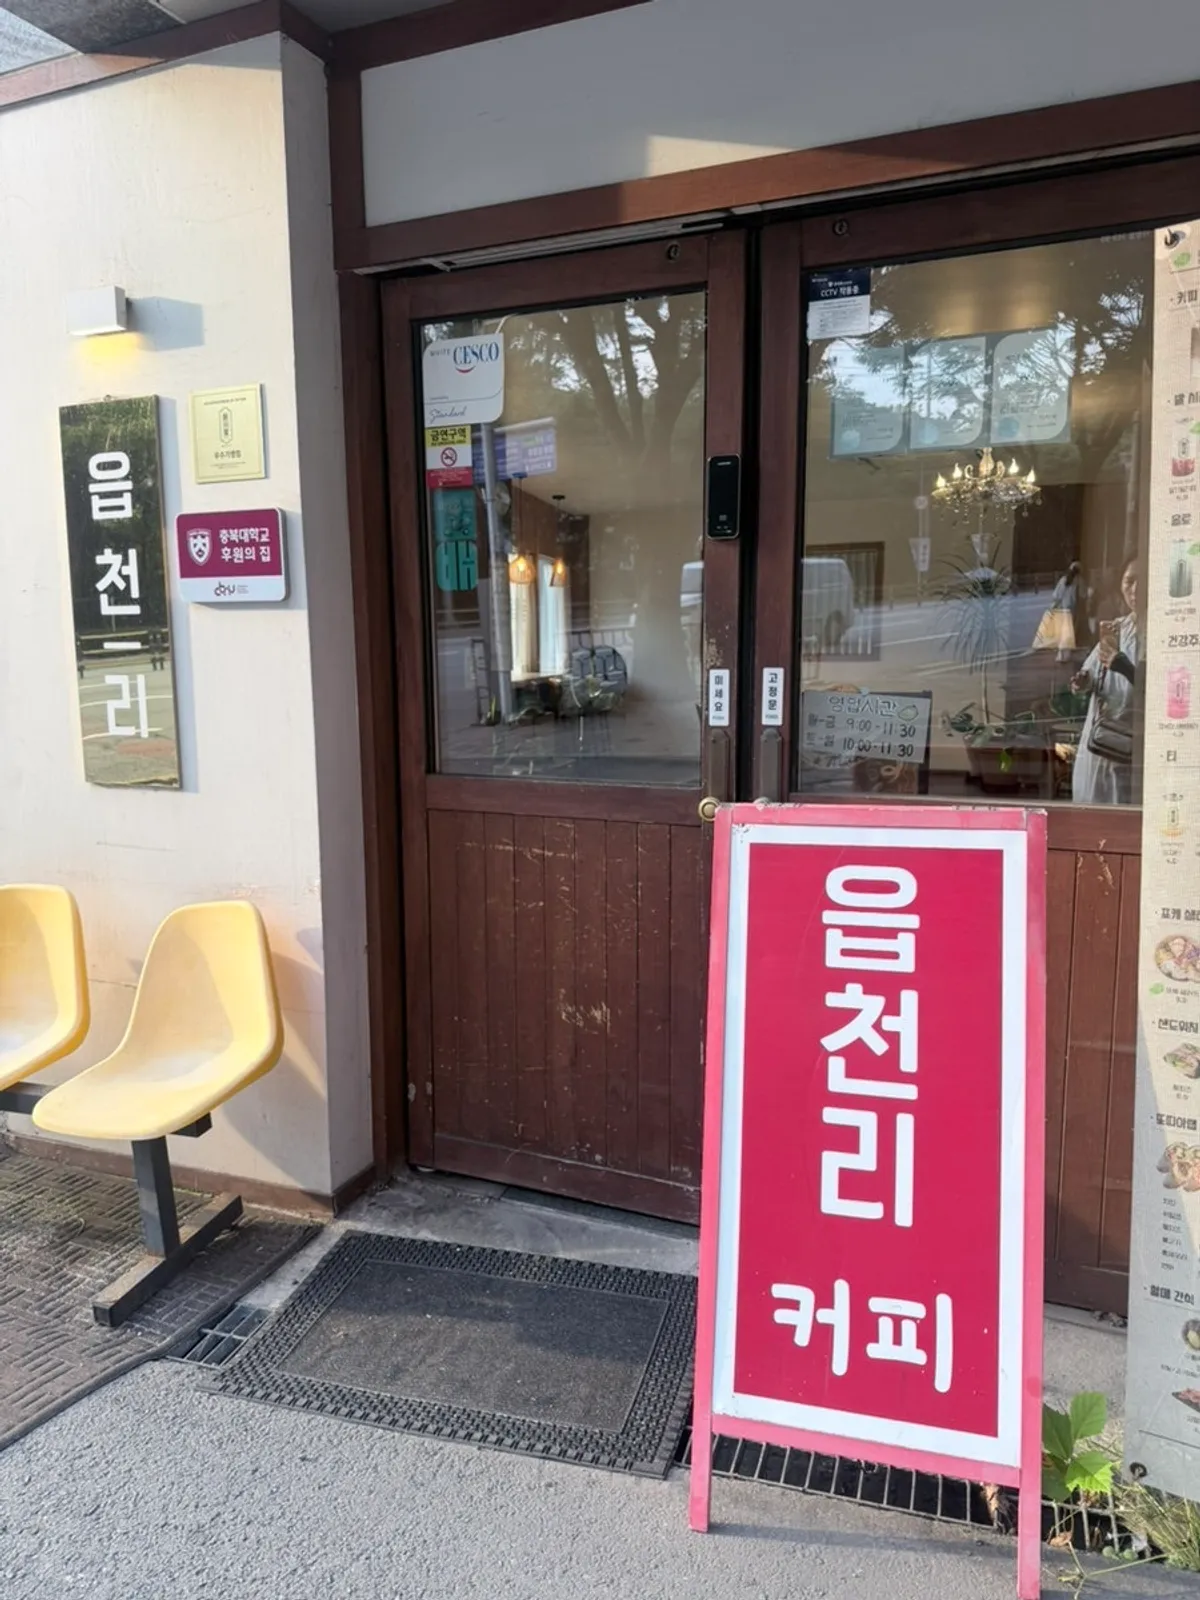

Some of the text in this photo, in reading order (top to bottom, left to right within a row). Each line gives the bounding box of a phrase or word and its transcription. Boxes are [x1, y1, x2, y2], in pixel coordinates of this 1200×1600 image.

[820, 288, 838, 298] CCTV
[1177, 289, 1198, 305] 커피
[453, 341, 500, 366] CESCO
[430, 427, 467, 441] 금연구역
[219, 527, 271, 544] 충북대학교
[221, 545, 272, 563] 후원의 집
[1168, 633, 1200, 648] 건강주
[714, 674, 724, 712] 미세요
[768, 672, 779, 711] 고정문
[829, 695, 898, 717] 영업시간
[1158, 1017, 1199, 1034] 샌드위치
[820, 864, 921, 1227] 읍천리
[771, 1278, 953, 1394] 커피
